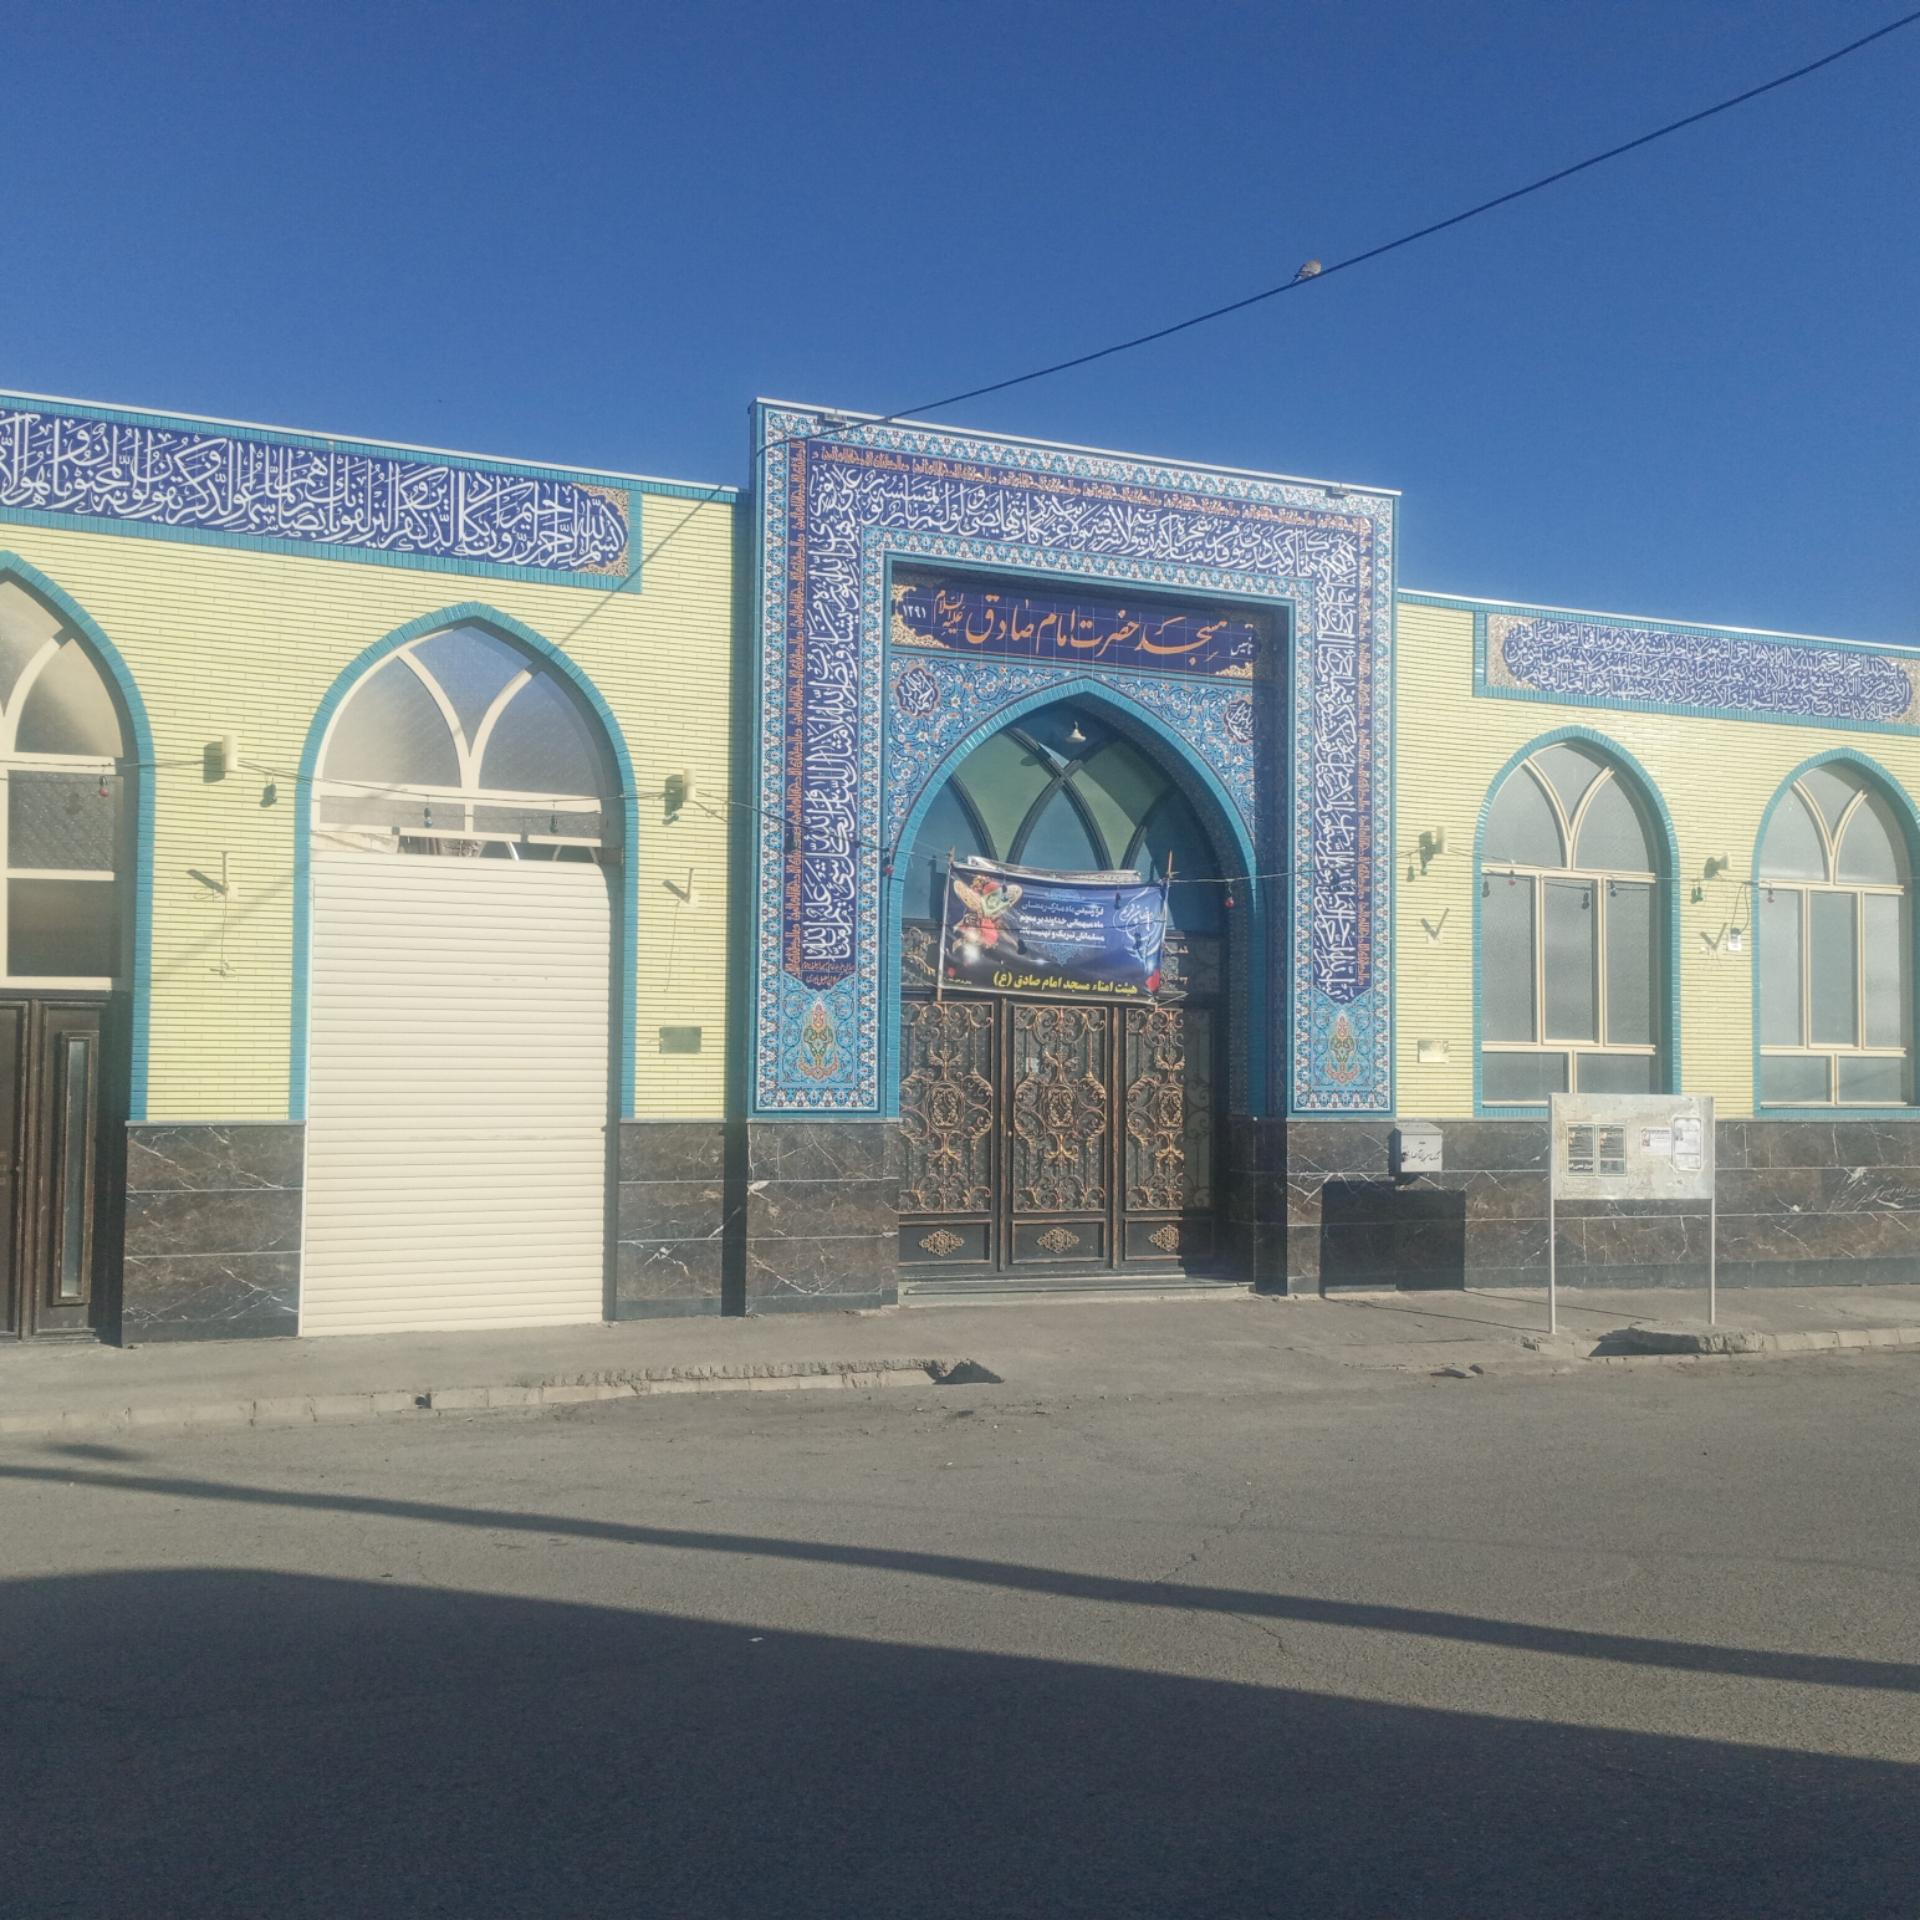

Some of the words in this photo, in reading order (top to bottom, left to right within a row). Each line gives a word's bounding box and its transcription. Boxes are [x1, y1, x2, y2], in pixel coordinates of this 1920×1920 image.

[965, 594, 1036, 645] صادق
[1036, 608, 1077, 655] امام
[1070, 609, 1140, 658] حضرت
[1134, 616, 1229, 666] مسجد
[1014, 974, 1041, 989] صادق
[1041, 976, 1063, 991] امام
[1062, 979, 1091, 993] مسجد
